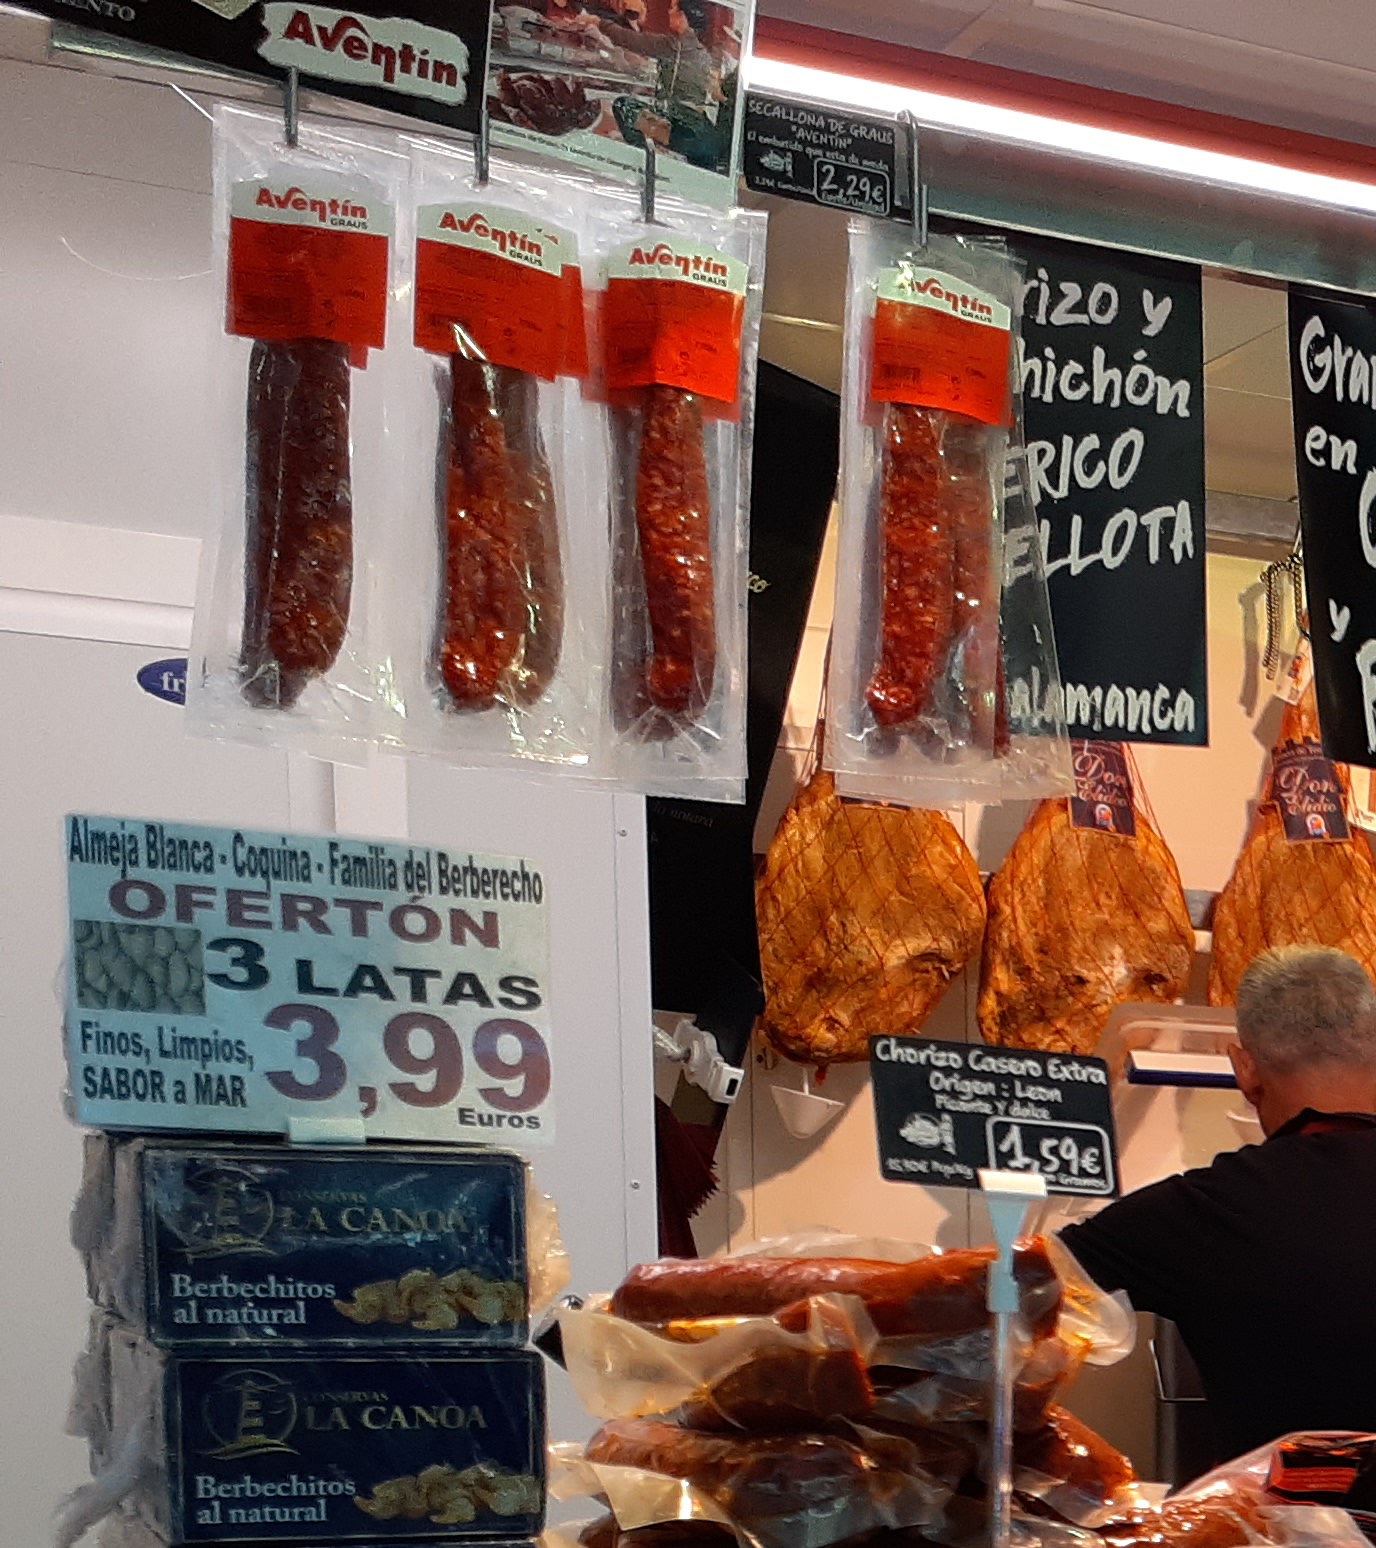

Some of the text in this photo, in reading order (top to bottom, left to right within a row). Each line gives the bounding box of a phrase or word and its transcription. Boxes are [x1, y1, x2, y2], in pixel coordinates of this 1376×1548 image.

[748, 100, 893, 145] SECALLONA DE GRAUS
[820, 164, 884, 202] 2,29€
[1305, 424, 1358, 474] en
[1328, 598, 1351, 643] y
[70, 816, 545, 905] Almeja Blanca Coquina Familia del Berberecho
[108, 878, 501, 949] OFERTÓN
[206, 938, 544, 1012] 3 LATAS
[81, 1020, 152, 1065] Finos,
[263, 1003, 552, 1118] 3,99
[876, 1038, 963, 1070] Chorizo
[1047, 1058, 1108, 1086] Extra
[83, 1066, 248, 1108] SABOR a MAR
[458, 1106, 542, 1131] Euros
[999, 1124, 1101, 1176] 1,59€
[172, 1273, 337, 1300] Berbechitos
[174, 1301, 307, 1325] al natural
[360, 1404, 488, 1430] CANOA
[195, 1474, 357, 1500] Berbechitos
